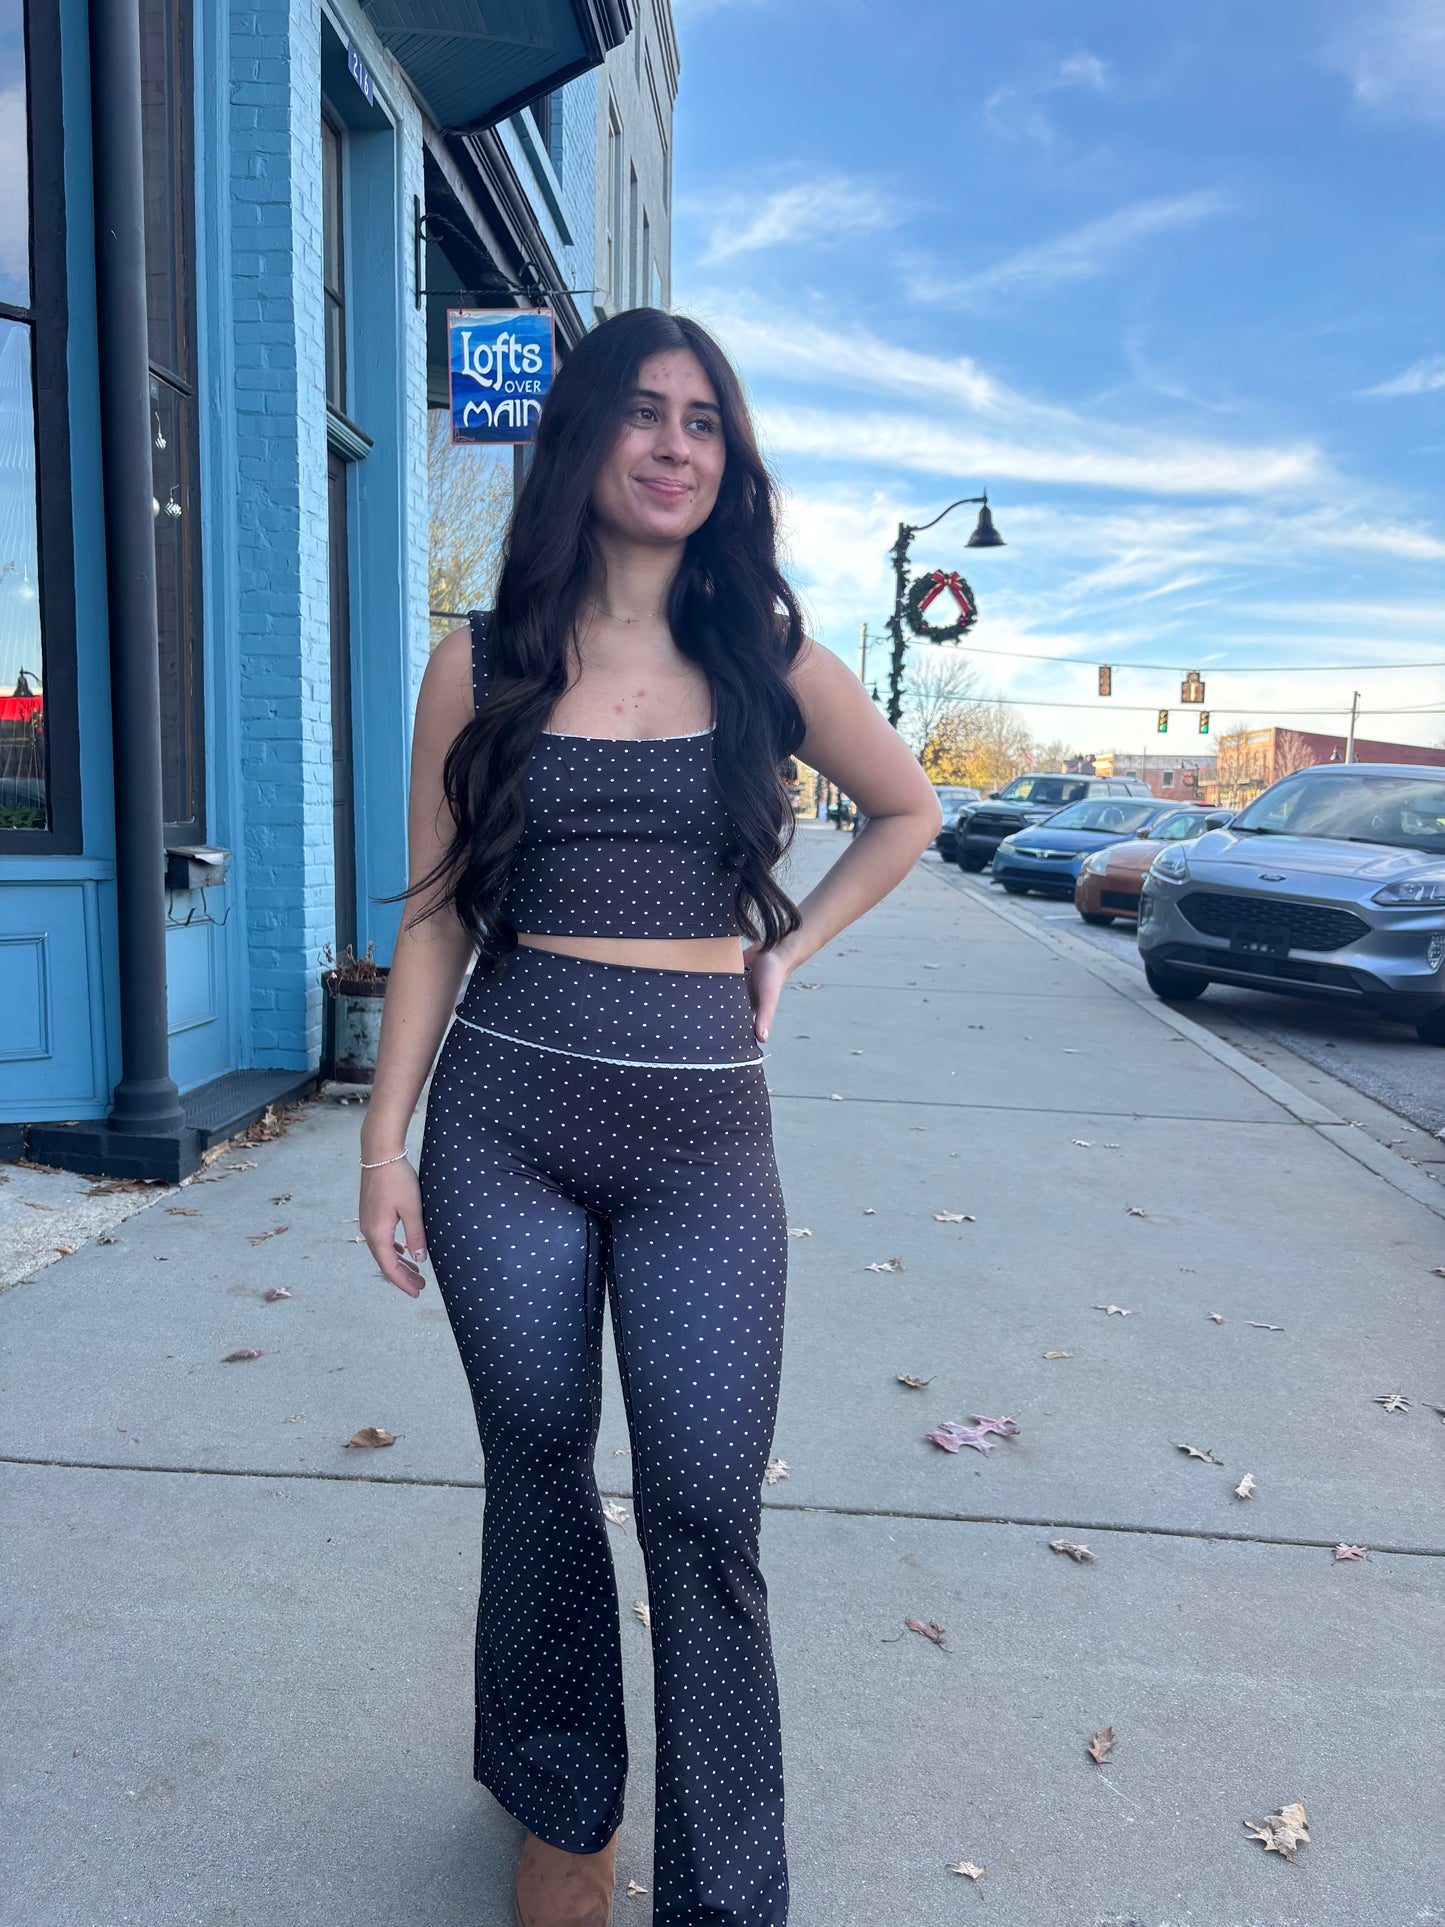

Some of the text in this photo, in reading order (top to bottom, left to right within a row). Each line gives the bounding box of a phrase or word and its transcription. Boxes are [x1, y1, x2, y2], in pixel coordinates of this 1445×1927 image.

[353, 52, 369, 96] 216
[460, 331, 543, 391] Lofts
[504, 380, 541, 393] OVER
